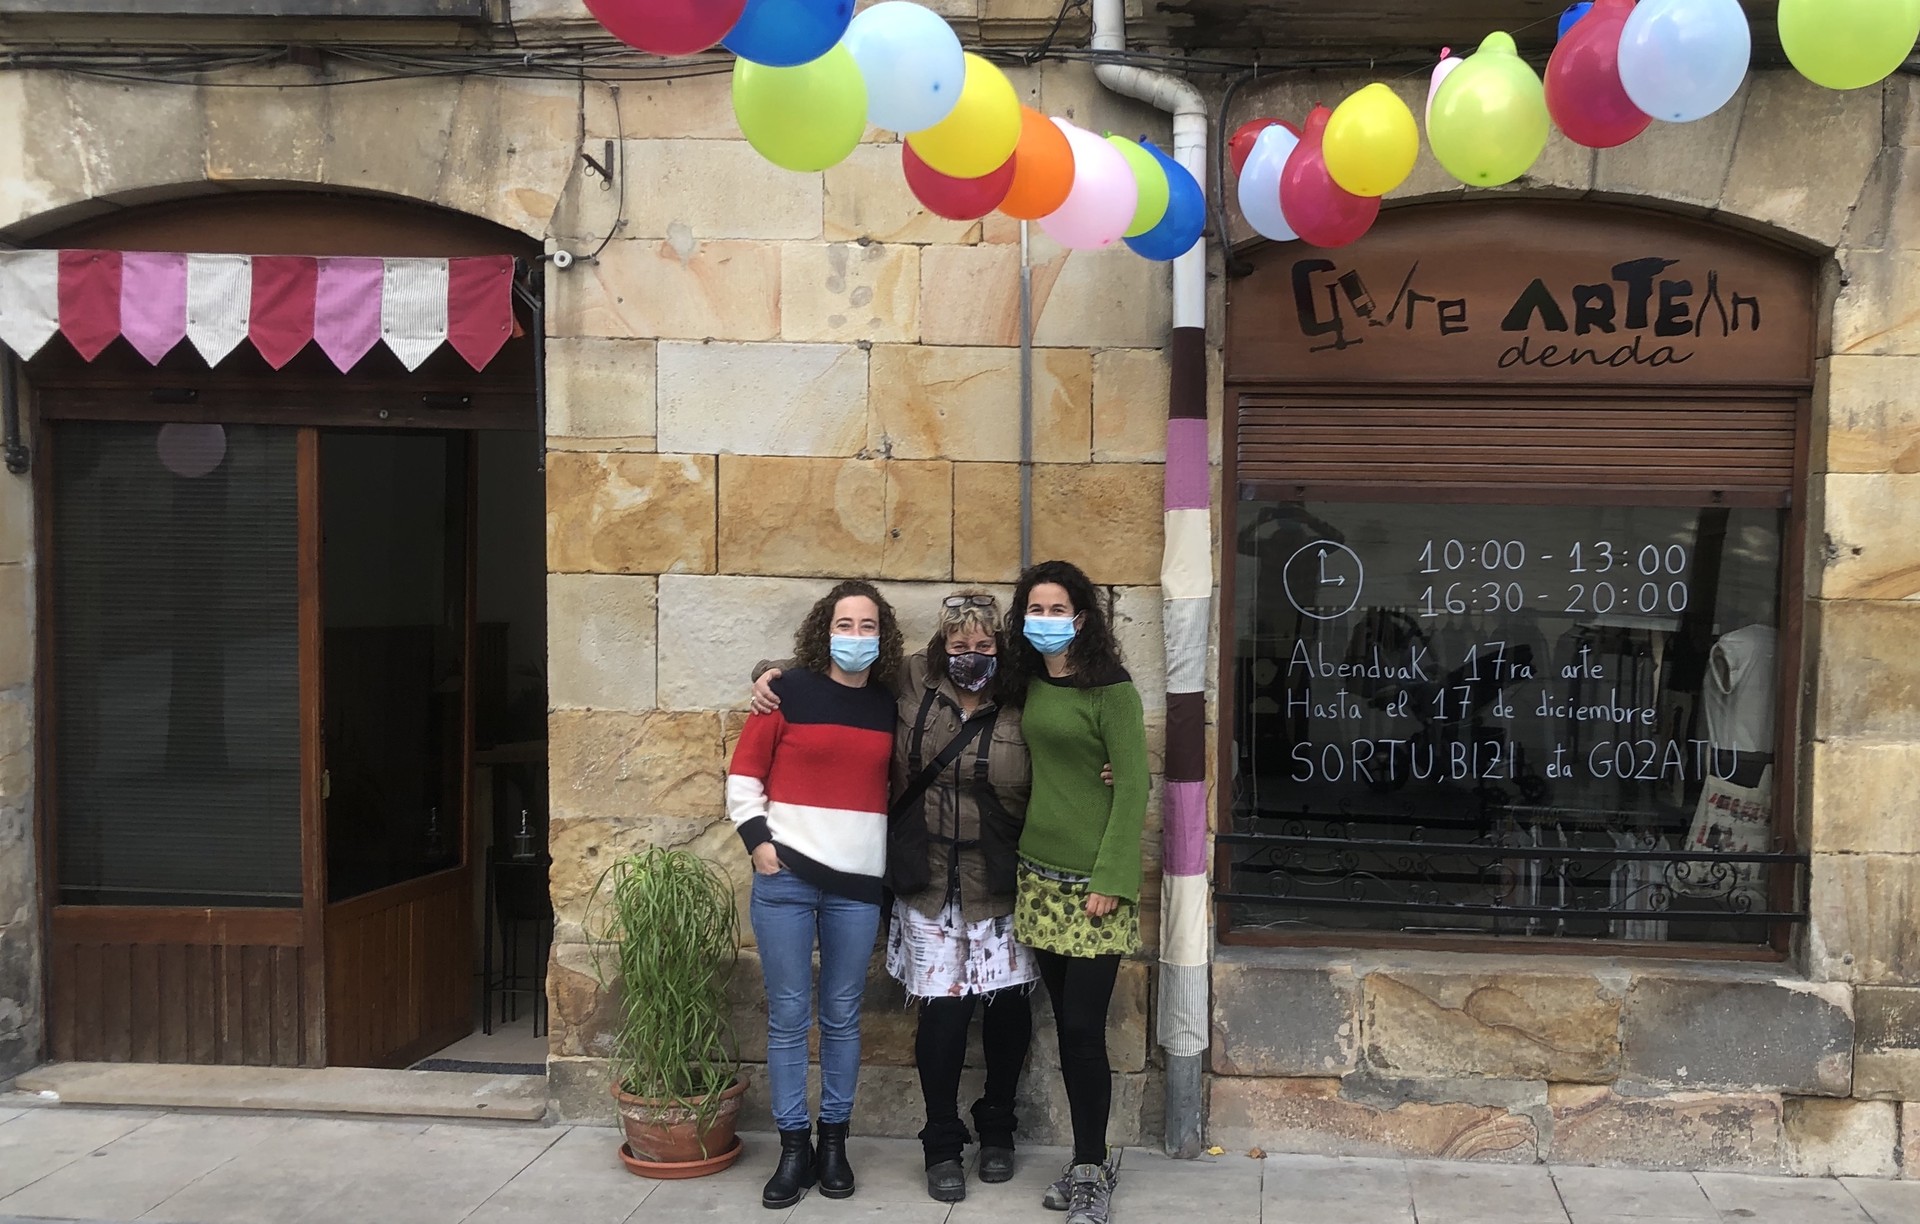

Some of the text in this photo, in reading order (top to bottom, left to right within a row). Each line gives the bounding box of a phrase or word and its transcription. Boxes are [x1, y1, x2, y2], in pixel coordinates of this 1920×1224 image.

[1497, 335, 1695, 369] denda
[1418, 538, 1526, 574] 10:00
[1568, 540, 1687, 576] 13:00
[1419, 581, 1524, 618] 16:30
[1563, 580, 1689, 614] 20:00
[1462, 640, 1534, 682] 17ra
[1560, 644, 1604, 679] arte
[1286, 685, 1657, 726] Hasta el 17 de diciembre
[1545, 742, 1574, 779] eta
[1587, 738, 1739, 782] GOZATU
